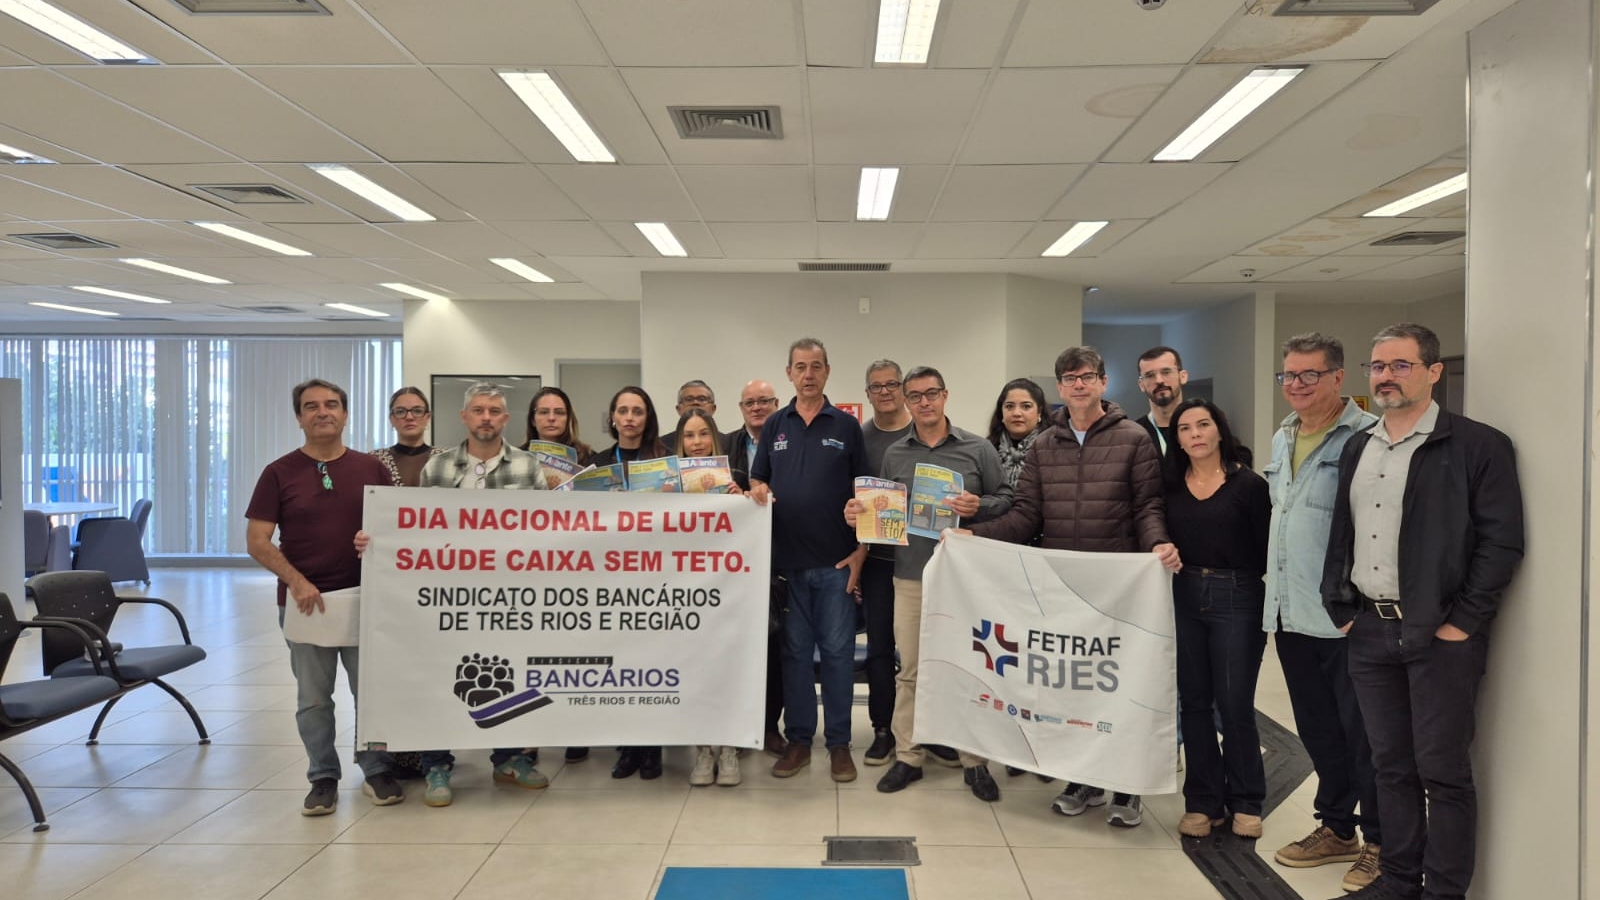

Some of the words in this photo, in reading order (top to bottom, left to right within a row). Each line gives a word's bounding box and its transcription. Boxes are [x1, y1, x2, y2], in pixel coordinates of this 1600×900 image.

[397, 508, 449, 530] DIA
[458, 508, 608, 532] NACIONAL
[617, 511, 653, 533] DE
[662, 511, 733, 533] LUTA
[396, 544, 496, 571] SAÚDE
[505, 549, 595, 572] CAIXA
[604, 550, 663, 572] SEM
[671, 551, 751, 573] TETO.
[417, 587, 537, 608] SINDICATO
[543, 587, 588, 607] DOS
[596, 583, 721, 608] BANCÁRIOS
[439, 611, 469, 631] DE
[476, 608, 533, 631] TRÊS
[540, 611, 592, 631] RIOS
[600, 611, 612, 631] E
[619, 608, 701, 631] REGIÃO
[1027, 630, 1121, 656] FETRAF
[526, 665, 680, 688] BANCÁRIOS
[1027, 654, 1119, 693] RJES
[567, 695, 596, 705] TRÊS
[599, 696, 625, 705] RIOS
[628, 696, 635, 705] E
[638, 695, 681, 705] REGIÃO
